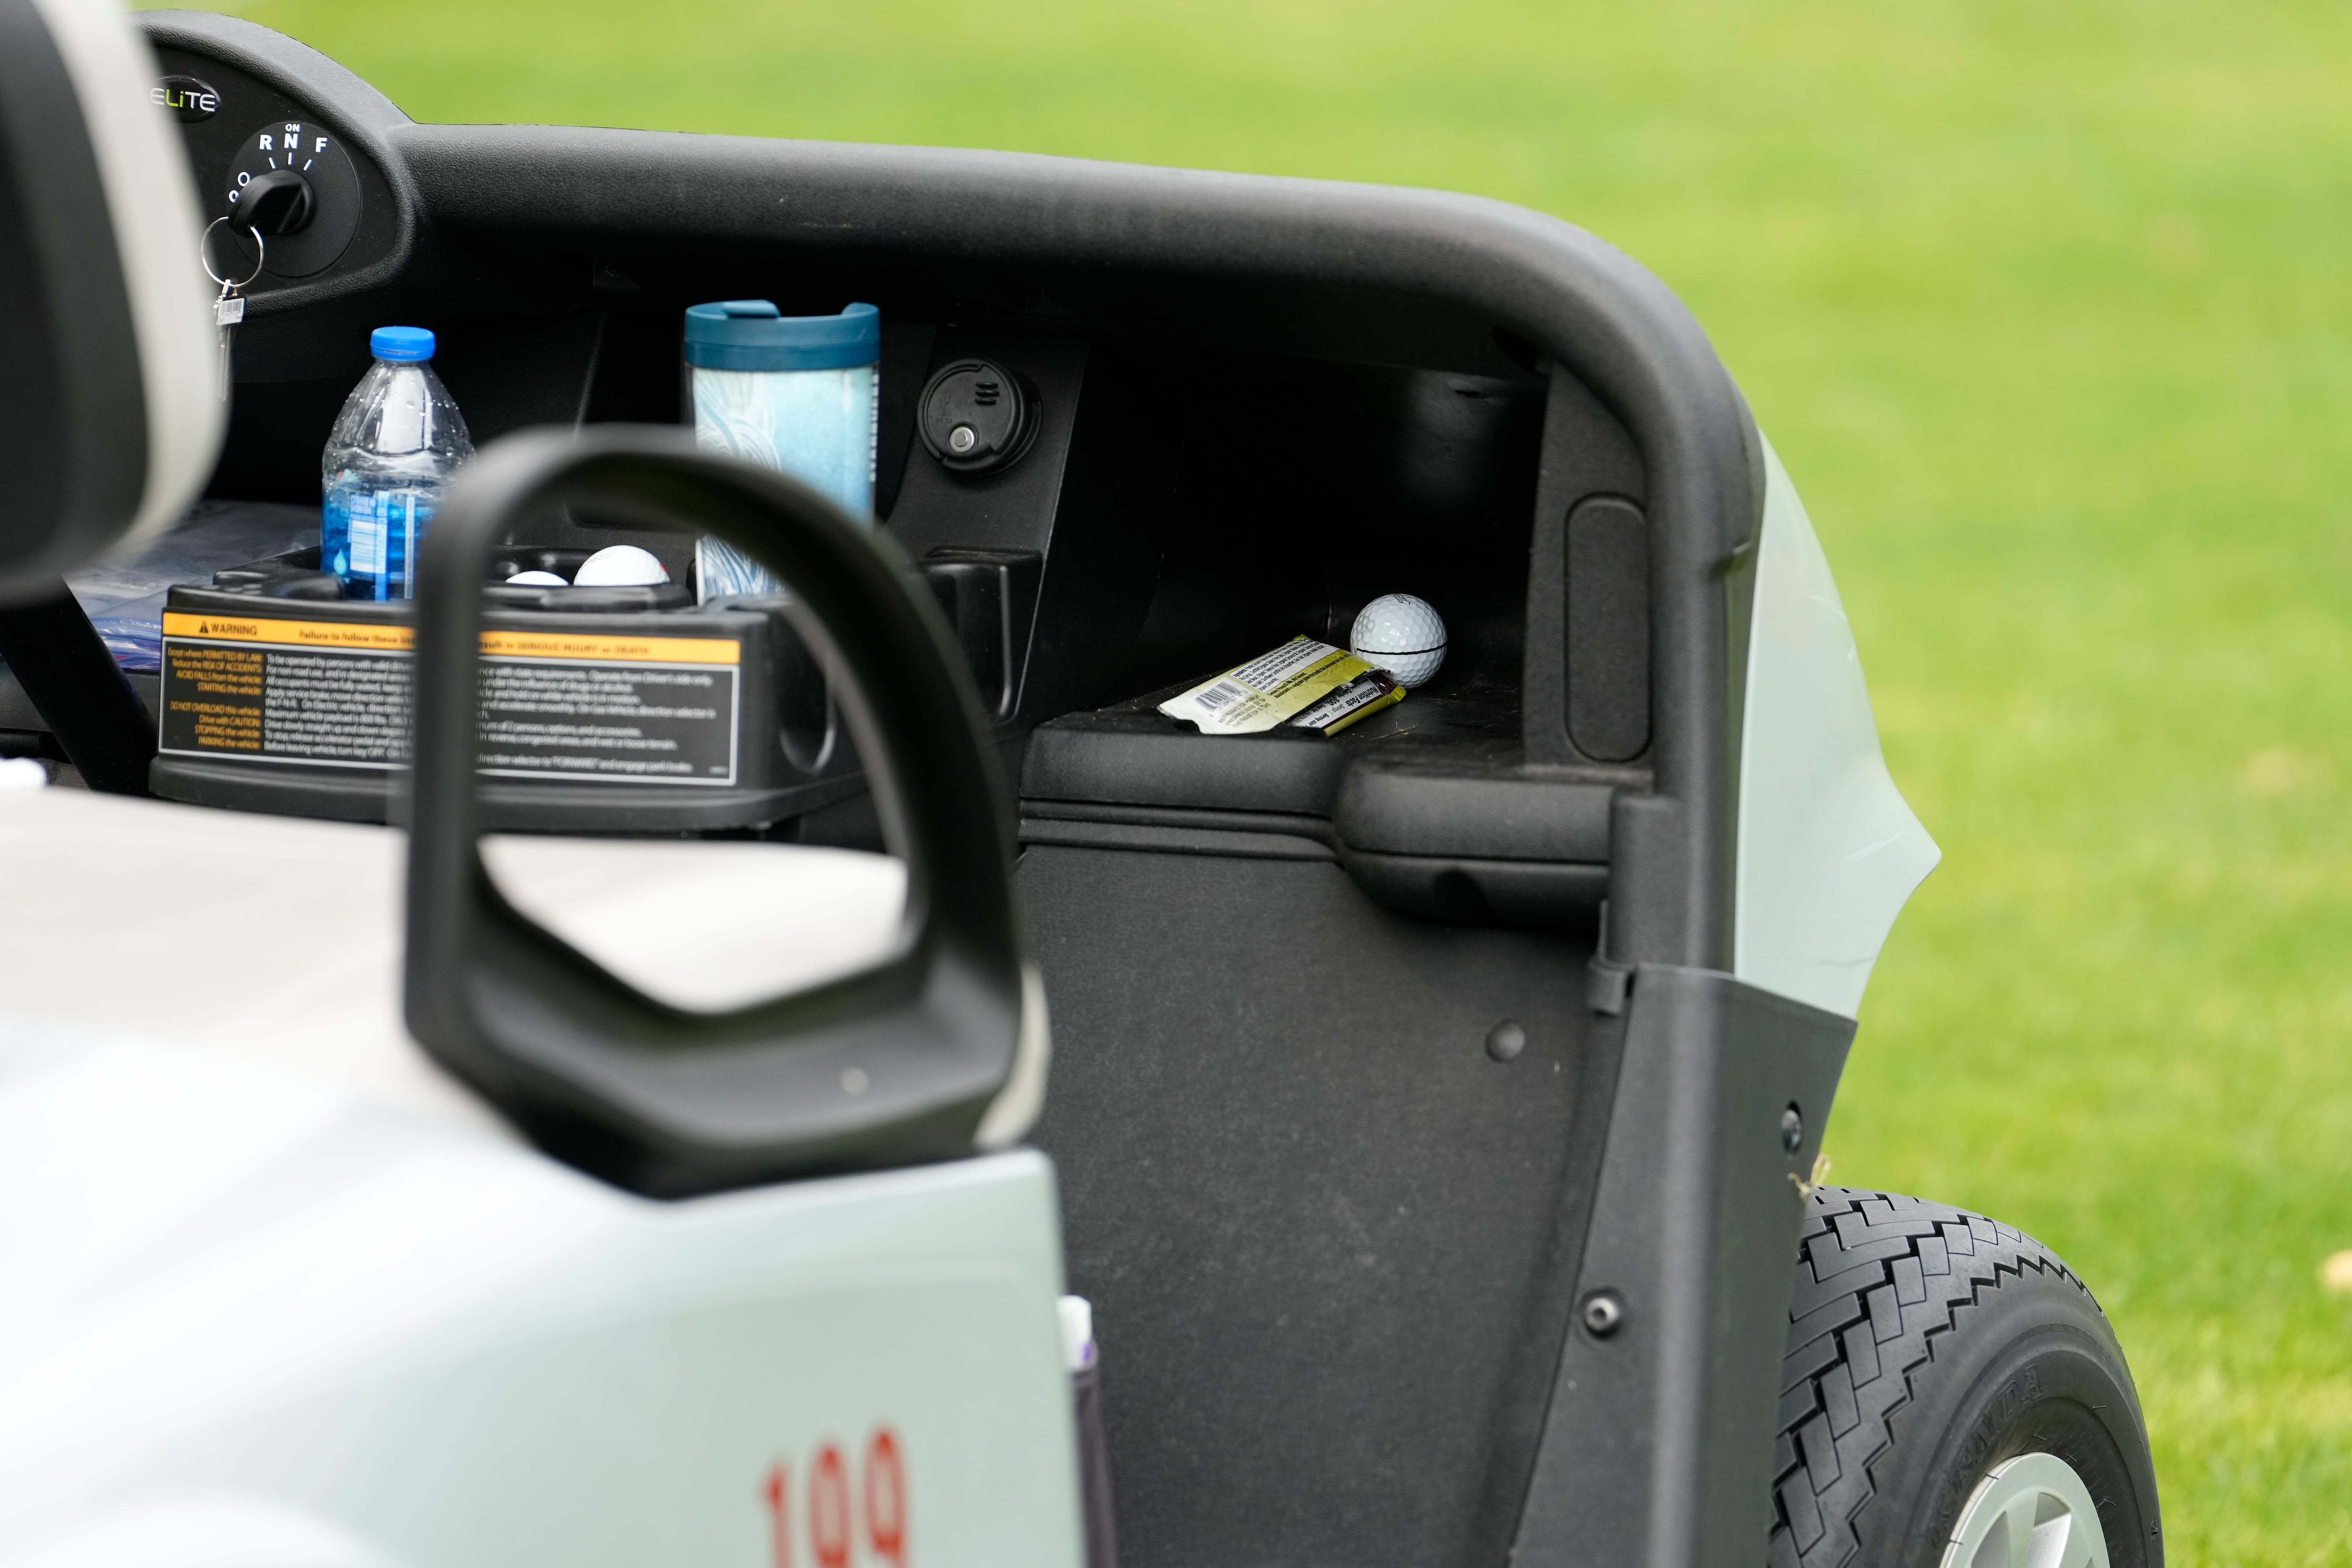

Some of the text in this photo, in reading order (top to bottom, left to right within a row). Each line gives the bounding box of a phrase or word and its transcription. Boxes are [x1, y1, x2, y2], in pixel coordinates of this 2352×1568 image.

[285, 124, 300, 132] ON
[259, 133, 327, 152] R N F
[211, 623, 257, 636] WARNING
[203, 649, 237, 661] PERMITTED
[176, 669, 193, 680] AVOID
[1336, 688, 1352, 698] Calories
[1356, 685, 1380, 700] Nutrition
[170, 700, 178, 711] DO
[179, 701, 191, 712] NOT
[191, 702, 225, 714] OVERLOAD
[1344, 696, 1361, 708] Facts
[1314, 712, 1329, 722] Serving
